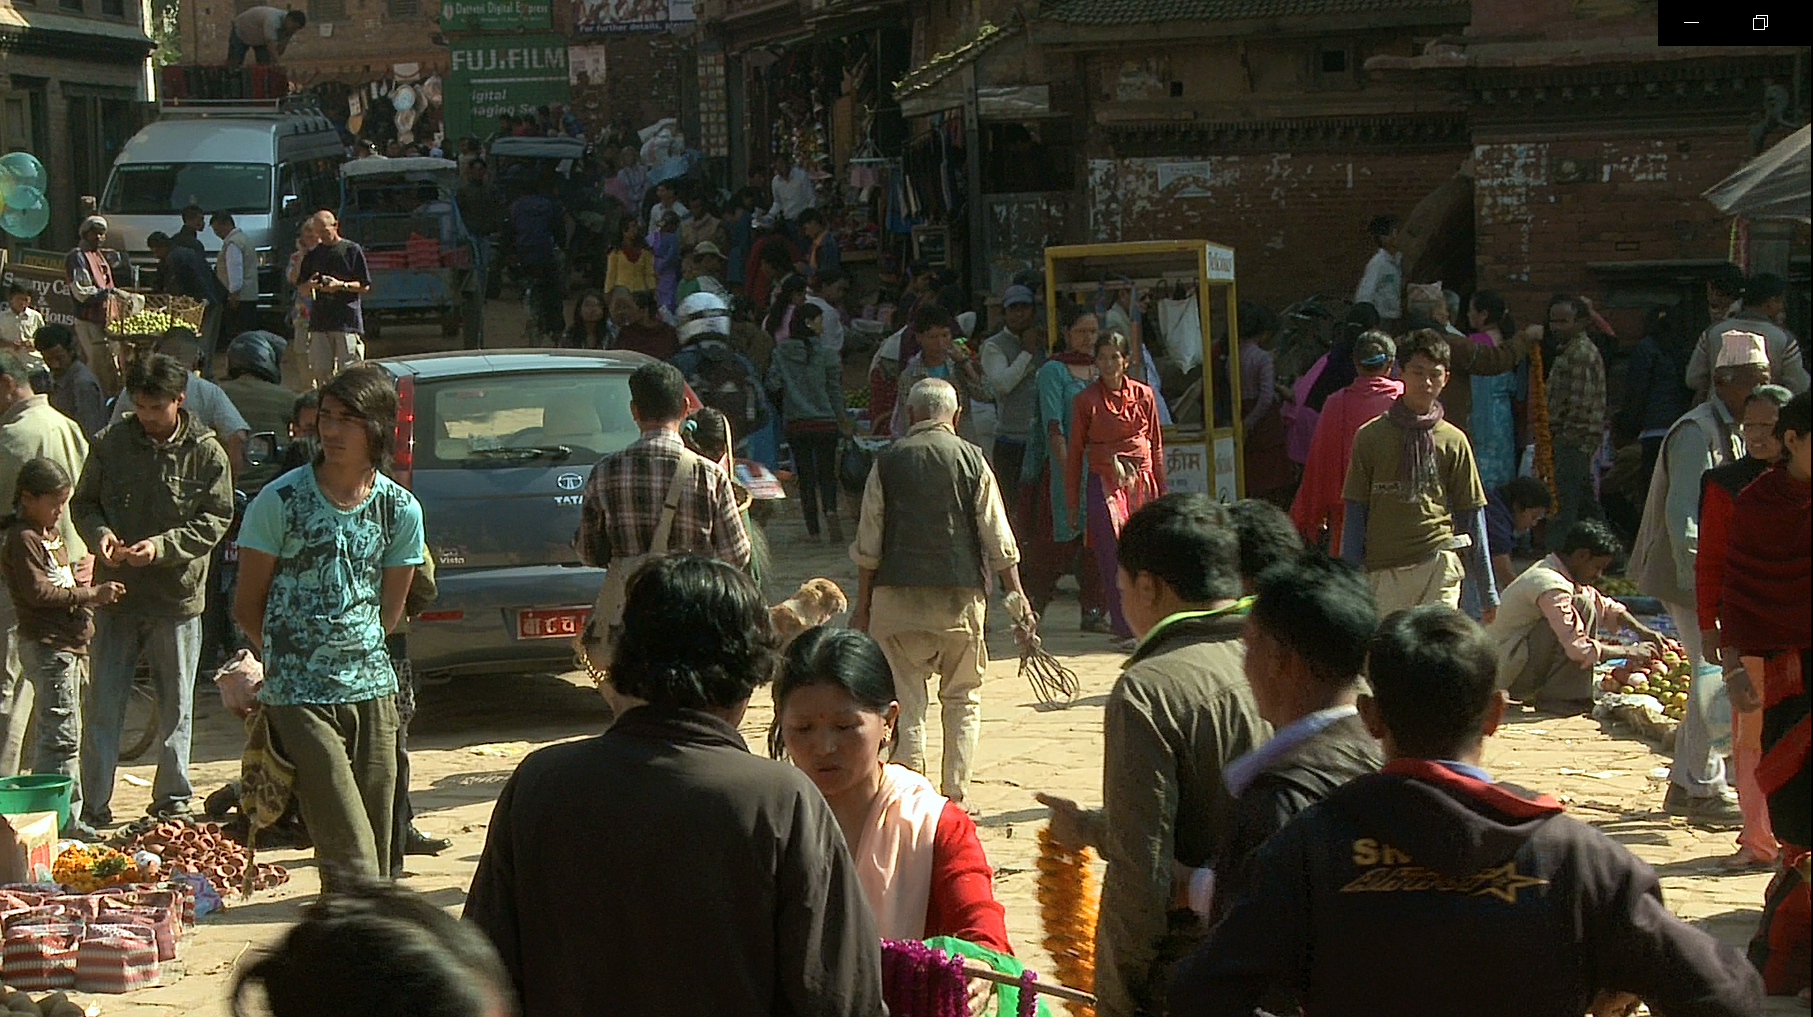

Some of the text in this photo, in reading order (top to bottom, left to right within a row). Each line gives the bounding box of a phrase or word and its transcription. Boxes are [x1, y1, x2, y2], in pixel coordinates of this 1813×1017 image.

[488, 2, 513, 15] Digital
[596, 23, 628, 33] further
[452, 47, 565, 71] FUJIFILM
[472, 89, 507, 104] igital
